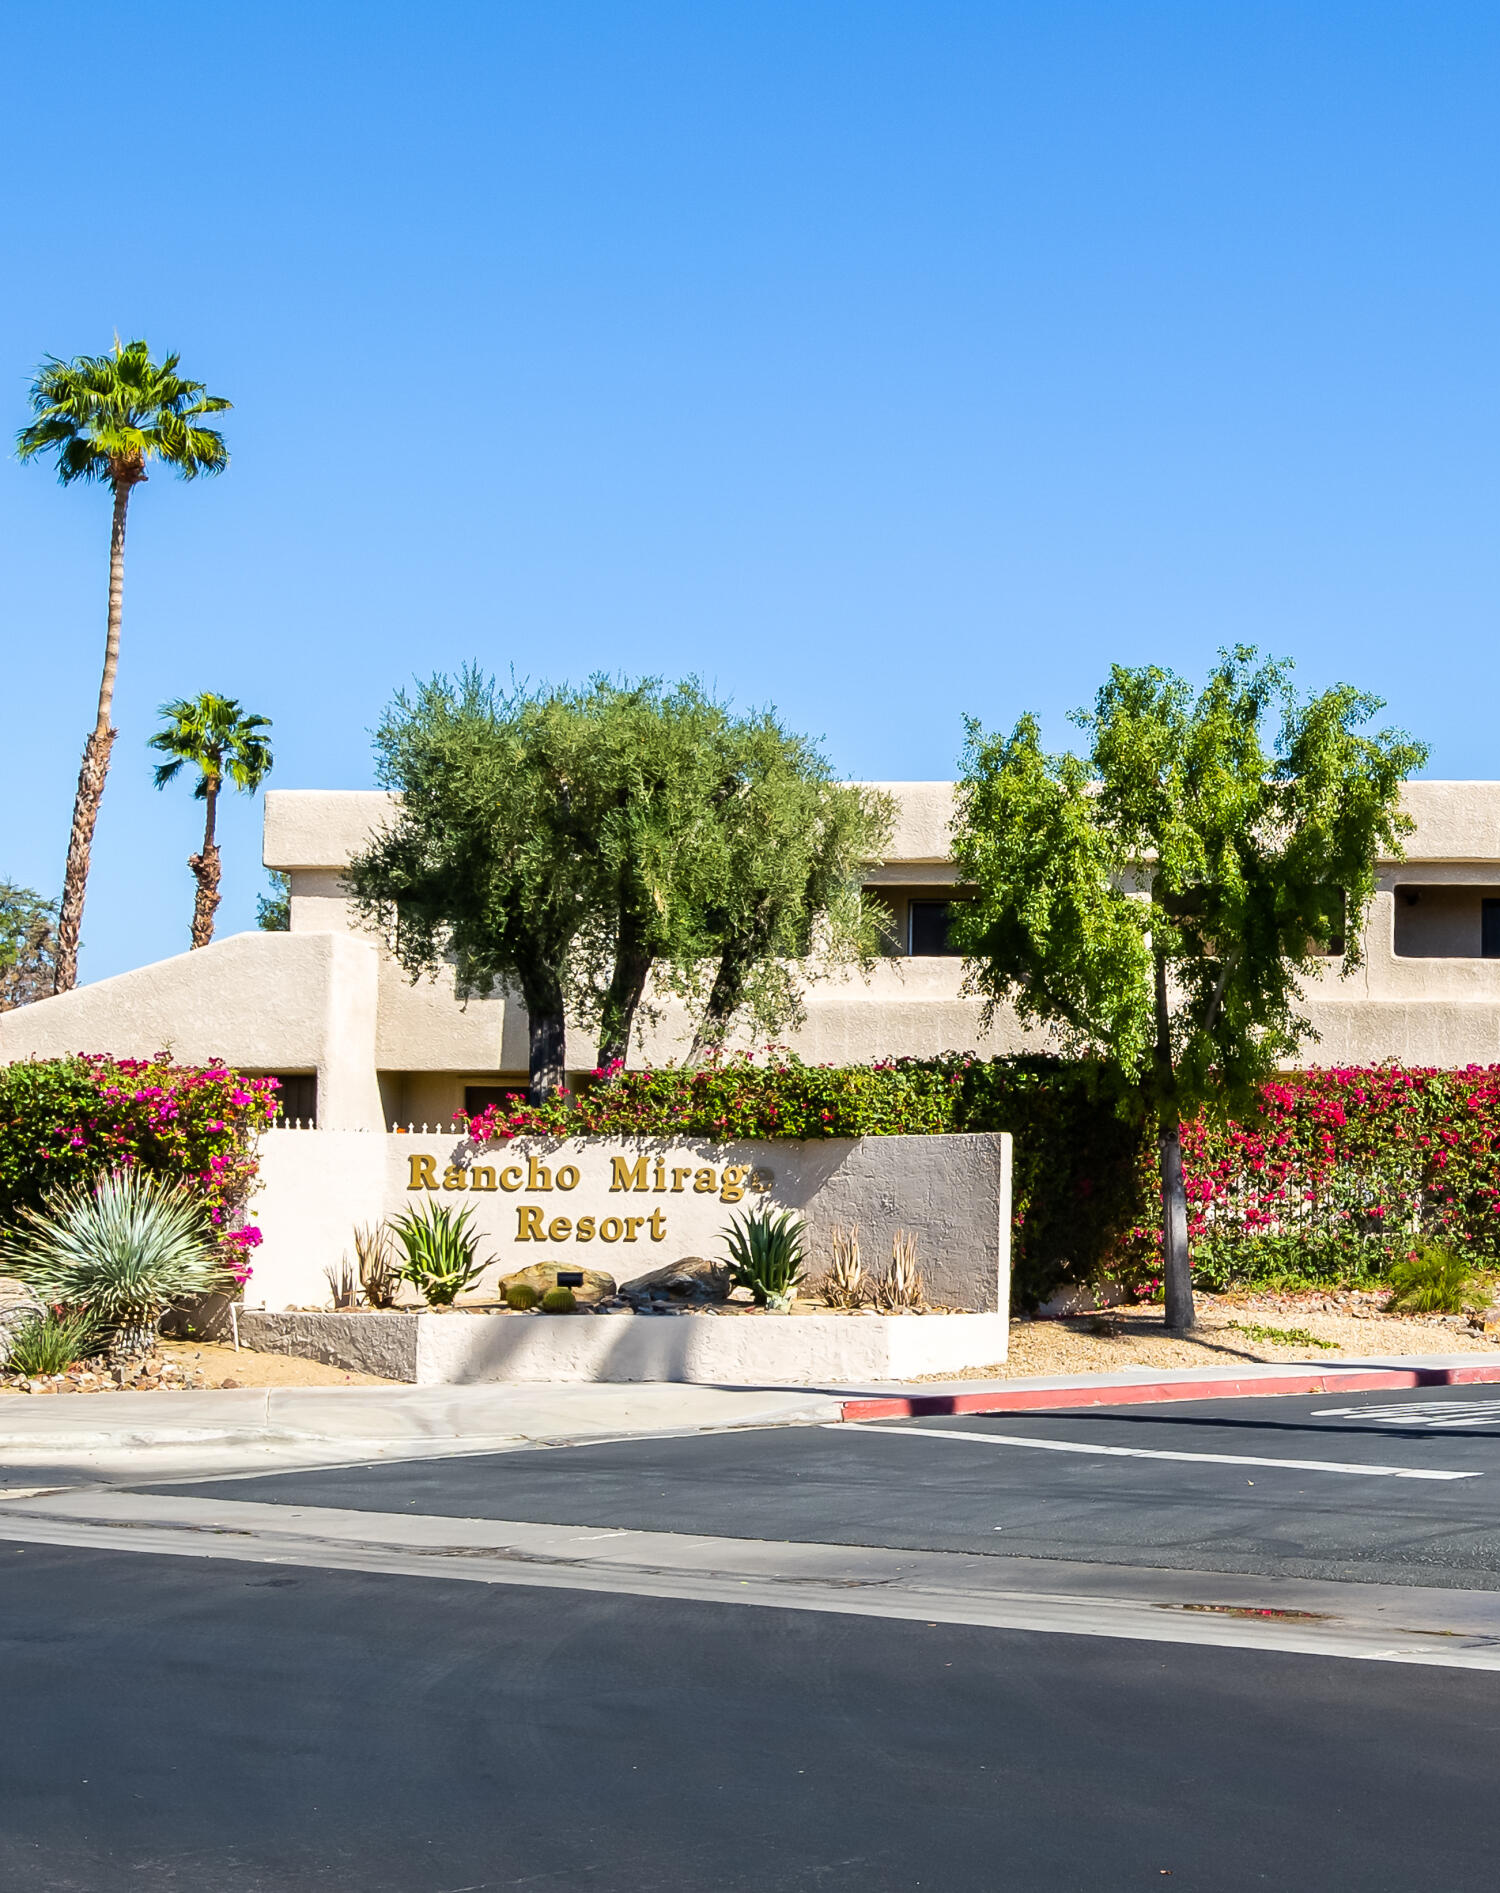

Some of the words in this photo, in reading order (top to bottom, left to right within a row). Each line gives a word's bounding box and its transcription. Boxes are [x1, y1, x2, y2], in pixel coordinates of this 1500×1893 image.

[407, 1154, 580, 1192] Rancho
[609, 1155, 774, 1203] Mirage
[515, 1205, 667, 1242] Resort
